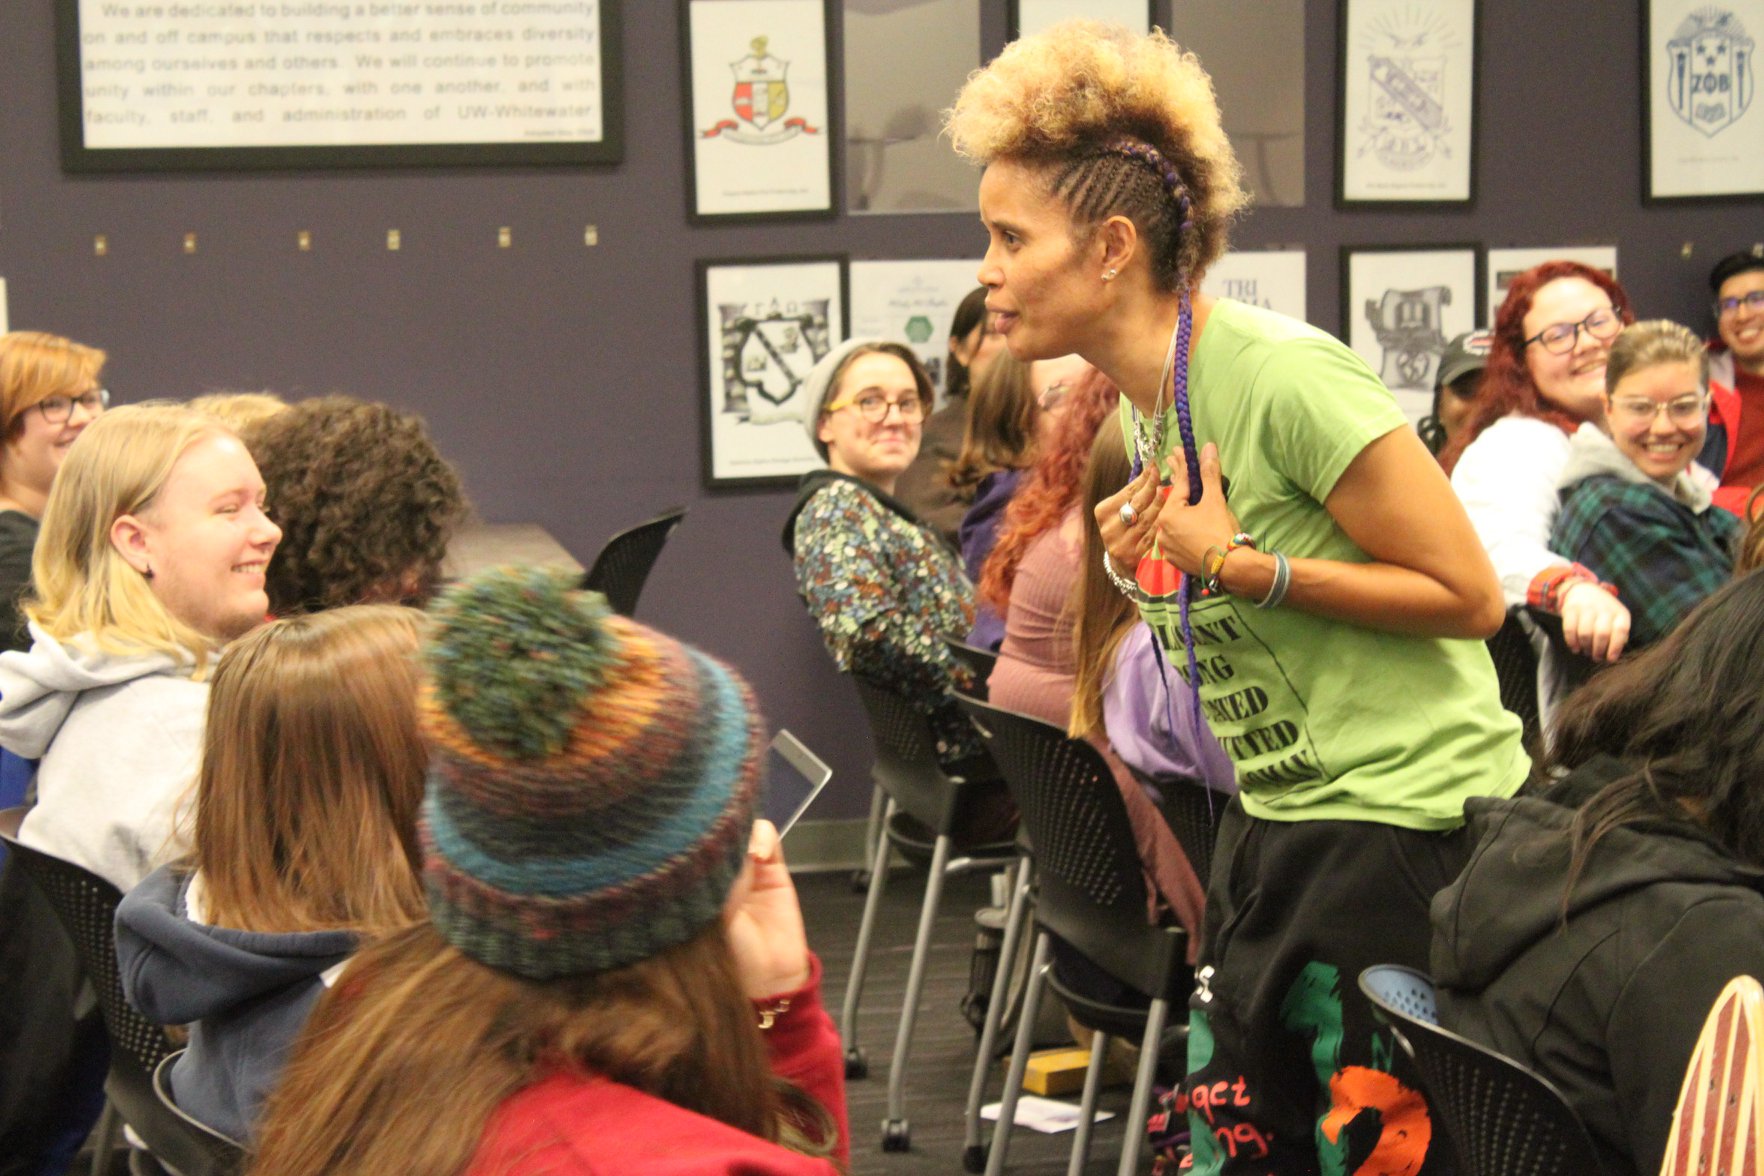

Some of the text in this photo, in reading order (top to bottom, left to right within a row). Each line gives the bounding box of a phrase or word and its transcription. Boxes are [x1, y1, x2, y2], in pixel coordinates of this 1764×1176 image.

[102, 0, 593, 20] We are dedicated to building a better sense of community
[83, 26, 594, 47] on and off campus that respects and embraces diversity
[85, 60, 146, 74] among
[152, 57, 237, 71] ourselves
[245, 56, 276, 70] and
[355, 54, 382, 68] We
[390, 54, 417, 68] will
[423, 54, 497, 67] continue
[504, 54, 518, 67] to
[525, 55, 594, 69] promote
[85, 85, 129, 99] unity
[143, 84, 194, 97] within
[207, 86, 235, 97] our
[344, 81, 378, 95] with
[391, 83, 422, 94] one
[518, 79, 549, 92] and
[562, 78, 595, 92] with
[232, 110, 264, 123] and
[283, 107, 406, 122] administration
[424, 106, 441, 120] of
[1222, 279, 1257, 298] TRI
